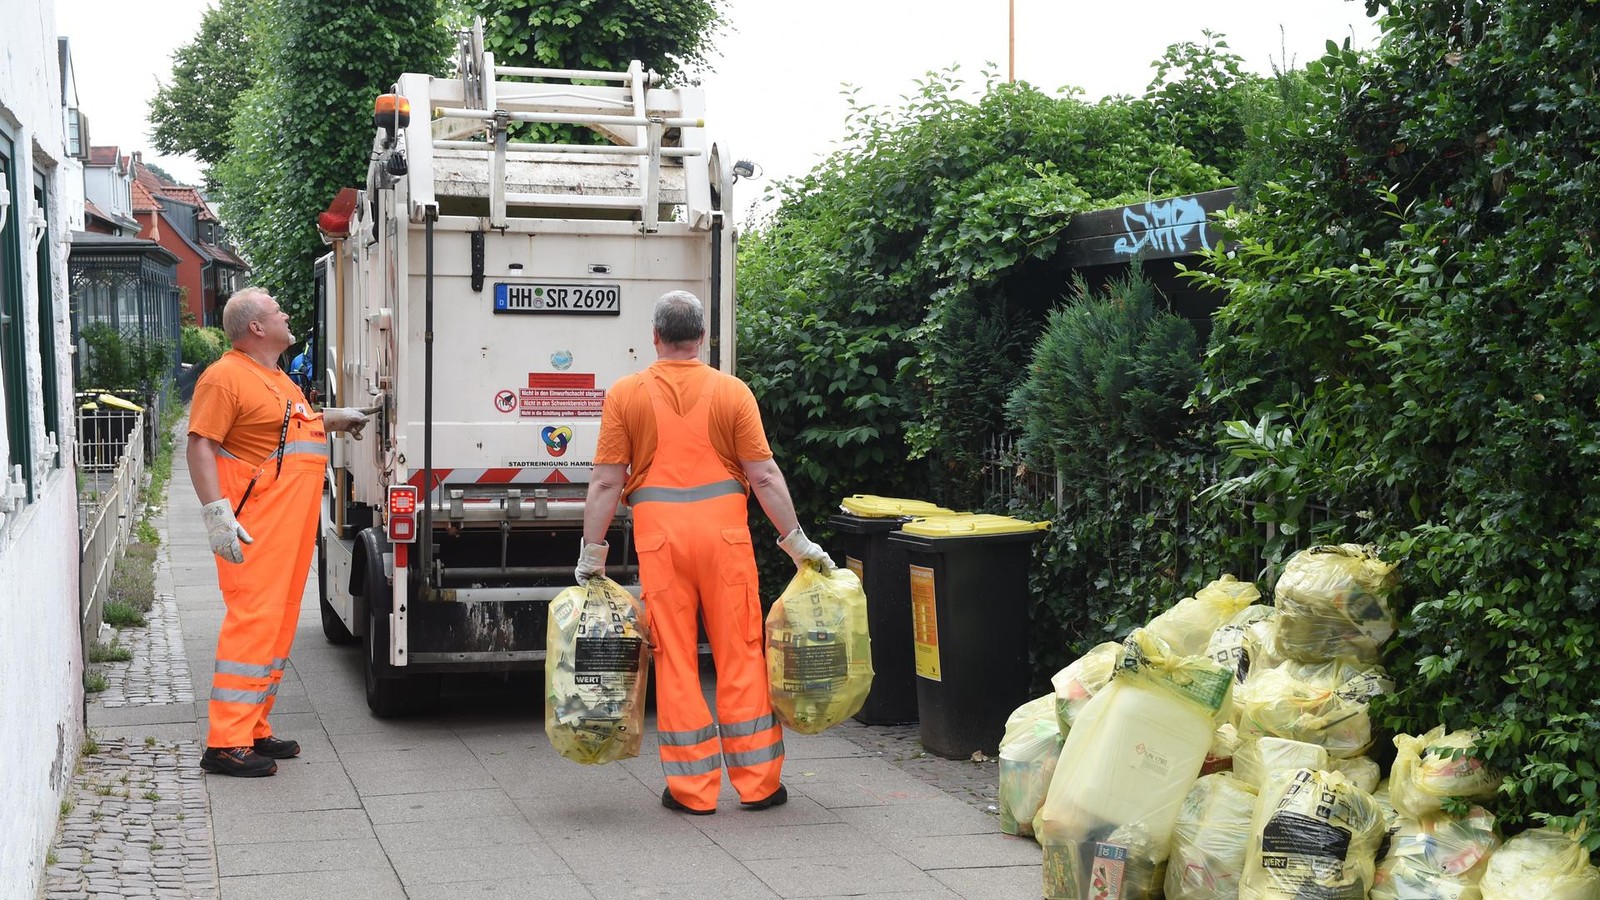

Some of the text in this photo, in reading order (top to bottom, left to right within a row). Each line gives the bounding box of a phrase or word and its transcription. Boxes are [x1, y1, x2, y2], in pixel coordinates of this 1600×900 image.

[509, 288, 616, 309] HH SR 2699
[1263, 858, 1287, 868] WERT
